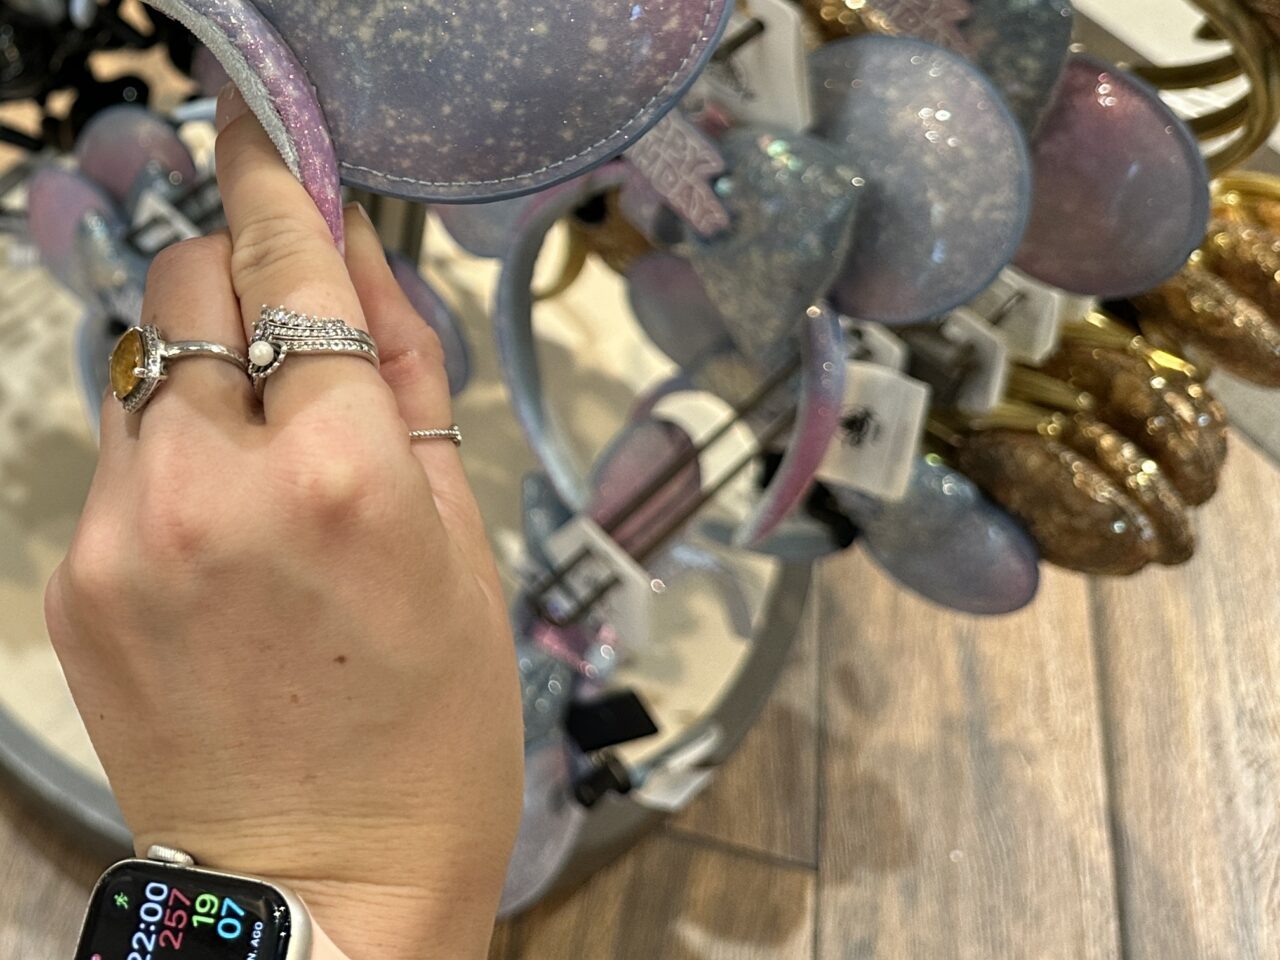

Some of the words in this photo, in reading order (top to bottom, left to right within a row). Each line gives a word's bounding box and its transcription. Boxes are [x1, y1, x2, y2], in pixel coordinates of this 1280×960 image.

[159, 888, 191, 950] 257
[192, 893, 219, 927] 19
[217, 897, 245, 939] 07
[250, 921, 263, 947] AGO
